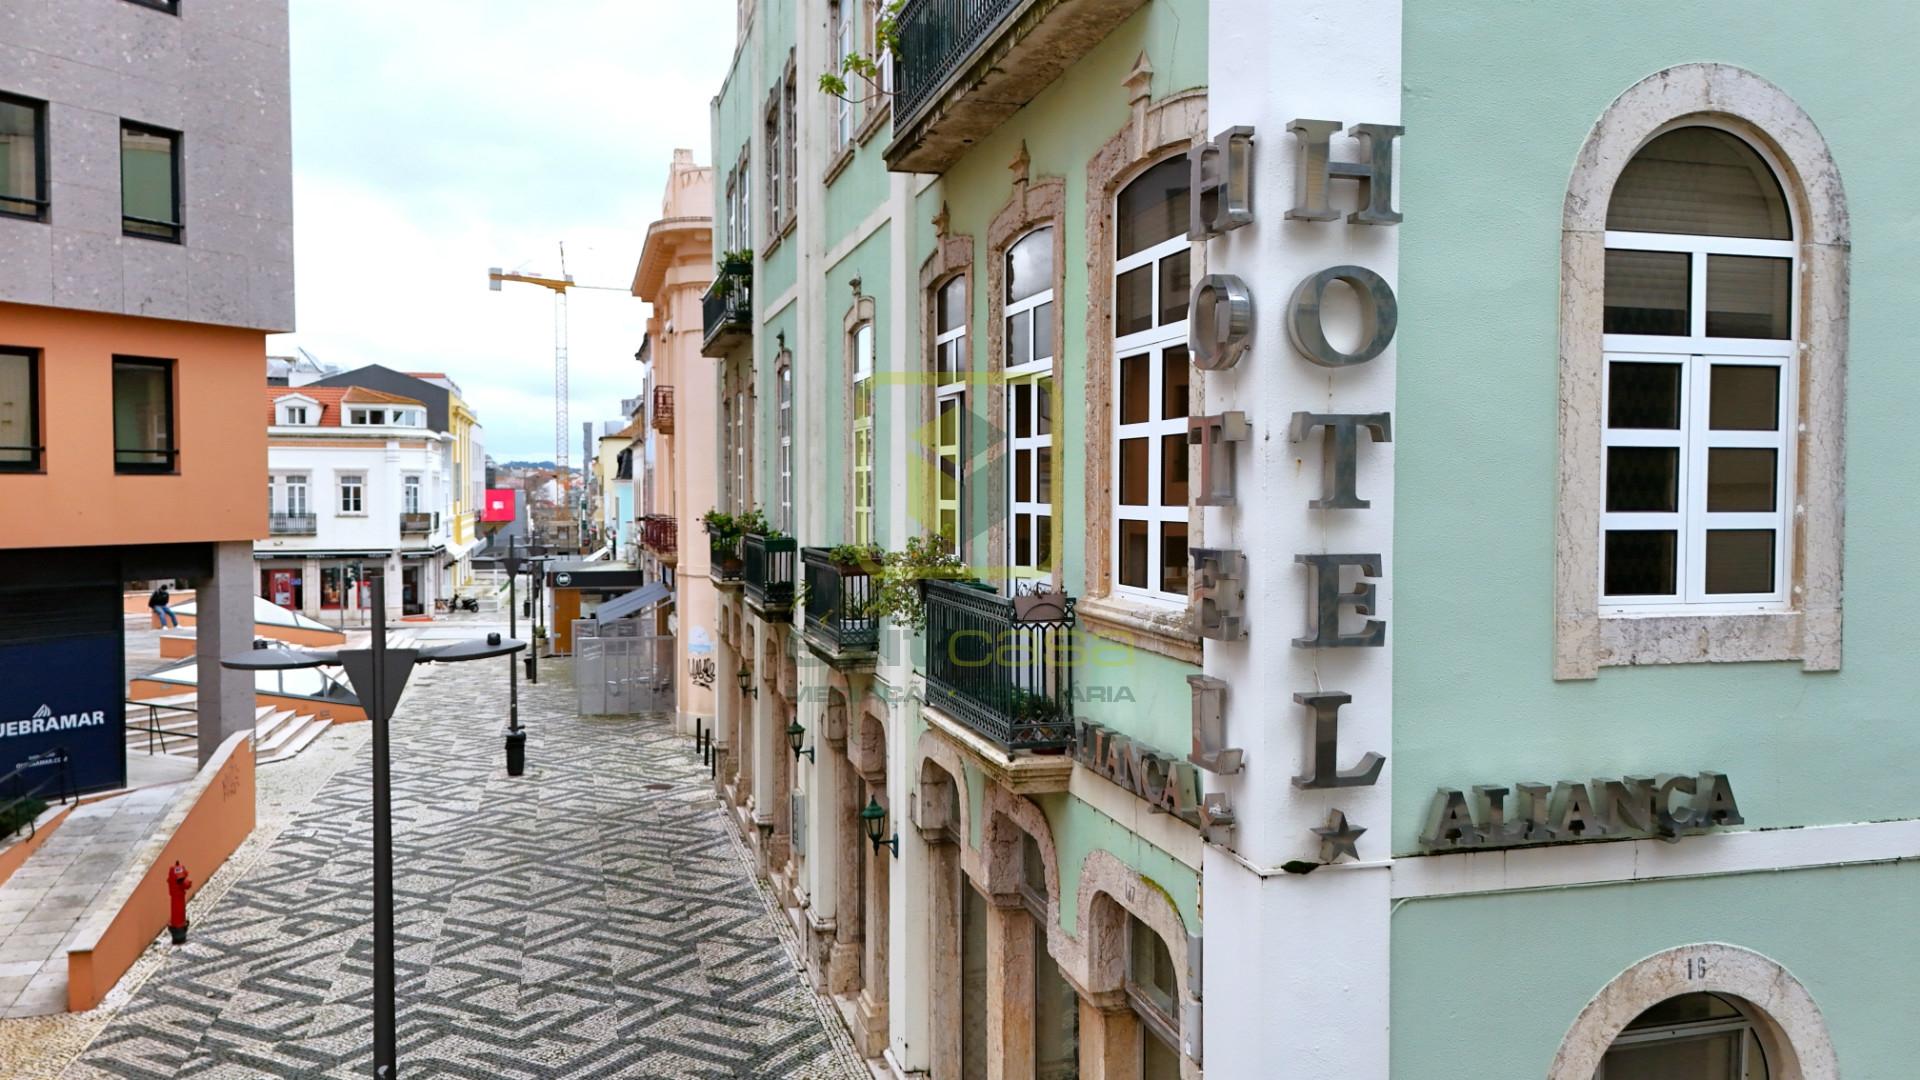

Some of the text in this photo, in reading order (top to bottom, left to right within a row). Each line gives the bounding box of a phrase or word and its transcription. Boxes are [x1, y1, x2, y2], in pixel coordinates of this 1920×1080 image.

[1187, 126, 1255, 775] HOTEL
[1284, 119, 1404, 789] HOTEL
[1419, 769, 1744, 844] ALIANÇA
